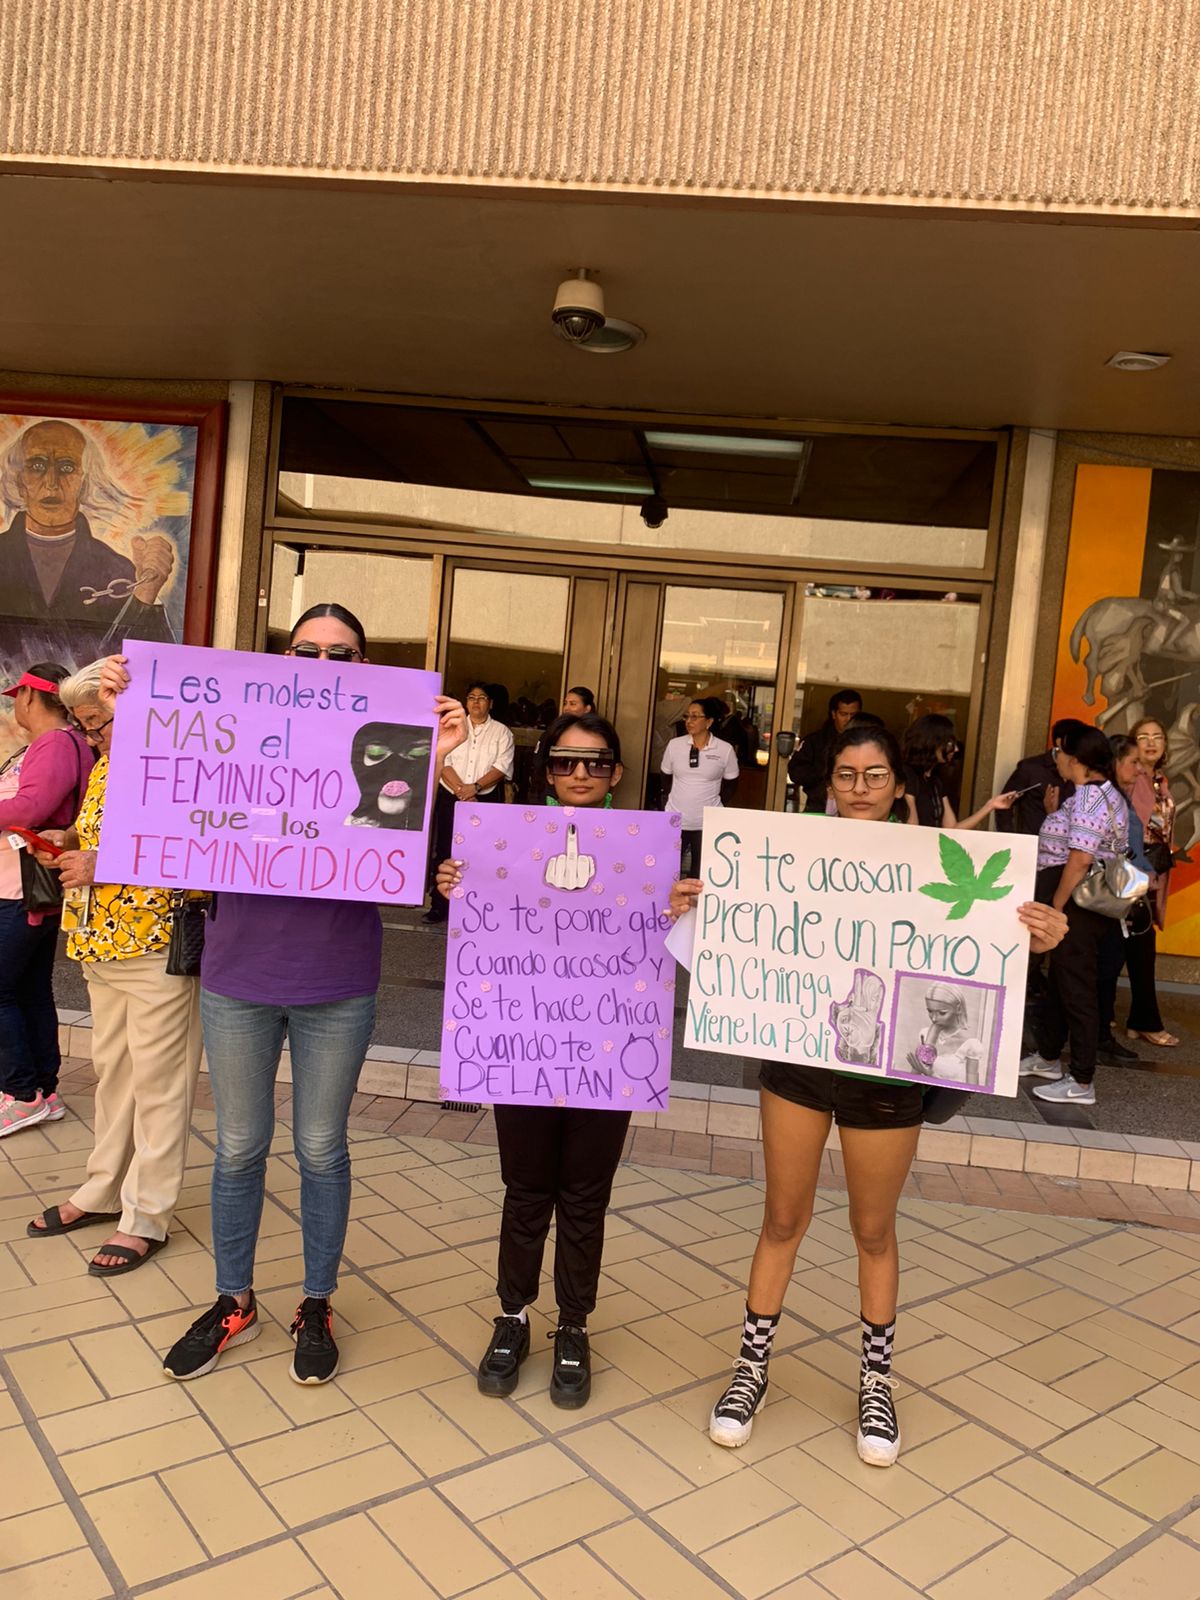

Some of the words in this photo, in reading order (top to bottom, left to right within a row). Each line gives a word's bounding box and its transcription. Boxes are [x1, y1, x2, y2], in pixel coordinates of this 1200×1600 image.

[151, 659, 221, 703] Les
[244, 673, 368, 712] molesta
[146, 708, 237, 754] MAS
[260, 718, 291, 759] el
[140, 756, 343, 810] FEMINISMO
[189, 809, 248, 836] que
[281, 811, 319, 839] los
[131, 834, 405, 895] FEMINICIDIOS
[708, 832, 741, 889] Si
[757, 837, 795, 893] te
[808, 857, 912, 893] acosan
[462, 891, 499, 933] Se
[510, 895, 542, 934] te
[555, 907, 621, 945] pone
[702, 894, 824, 958] Prende
[835, 917, 876, 967] un
[890, 920, 980, 976] Porro
[457, 941, 546, 976] Cuando
[553, 946, 637, 979] acosas
[696, 950, 735, 997] en
[452, 981, 487, 1020] Se
[493, 984, 523, 1021] te
[532, 986, 590, 1023] hace
[455, 1026, 555, 1063] Cuando
[562, 1032, 595, 1062] te
[783, 1017, 832, 1061] Poli
[455, 1061, 612, 1100] DELATAN
